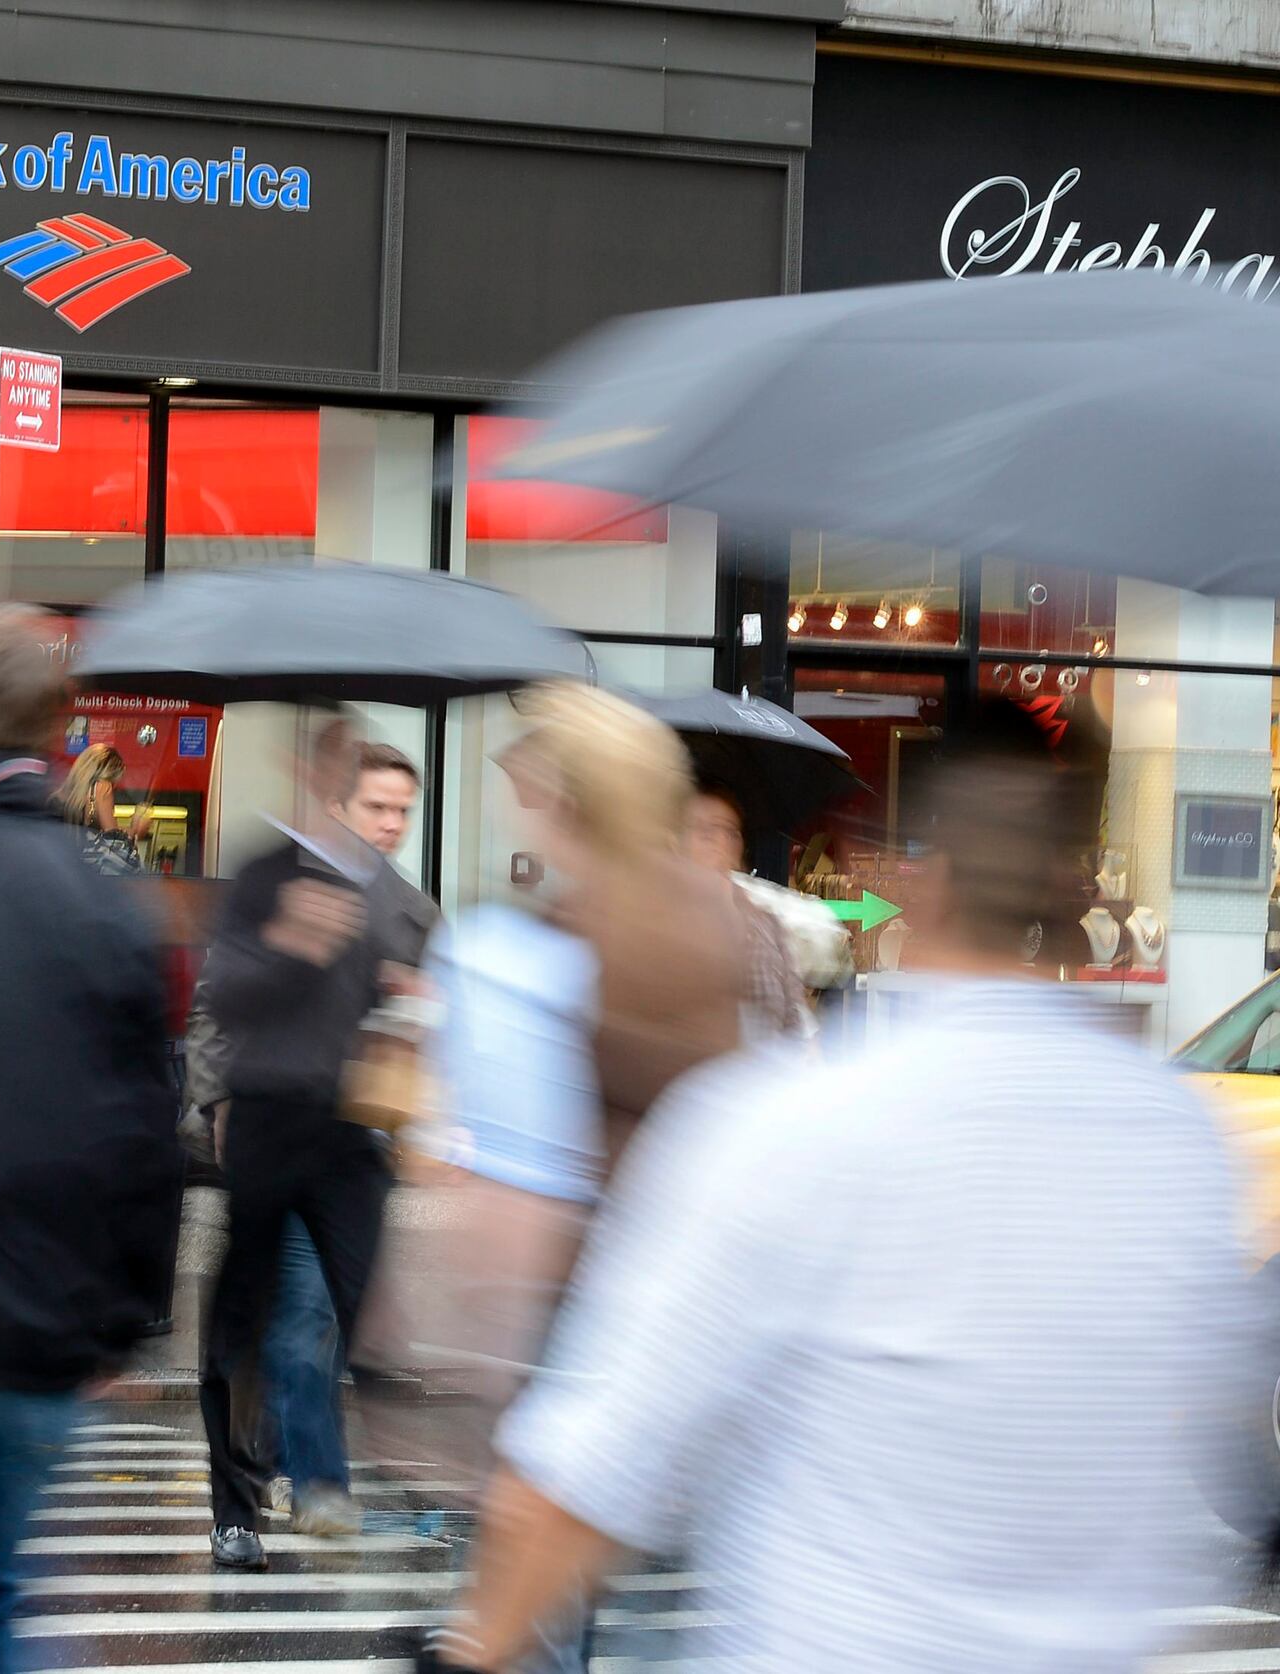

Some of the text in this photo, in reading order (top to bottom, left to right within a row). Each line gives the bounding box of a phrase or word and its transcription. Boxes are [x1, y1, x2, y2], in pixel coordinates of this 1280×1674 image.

[12, 131, 74, 193] of
[76, 134, 312, 213] America
[2, 358, 58, 388] NO STANDING
[8, 384, 51, 410] ANYTIME
[74, 695, 191, 712] Multi-Check Deposit
